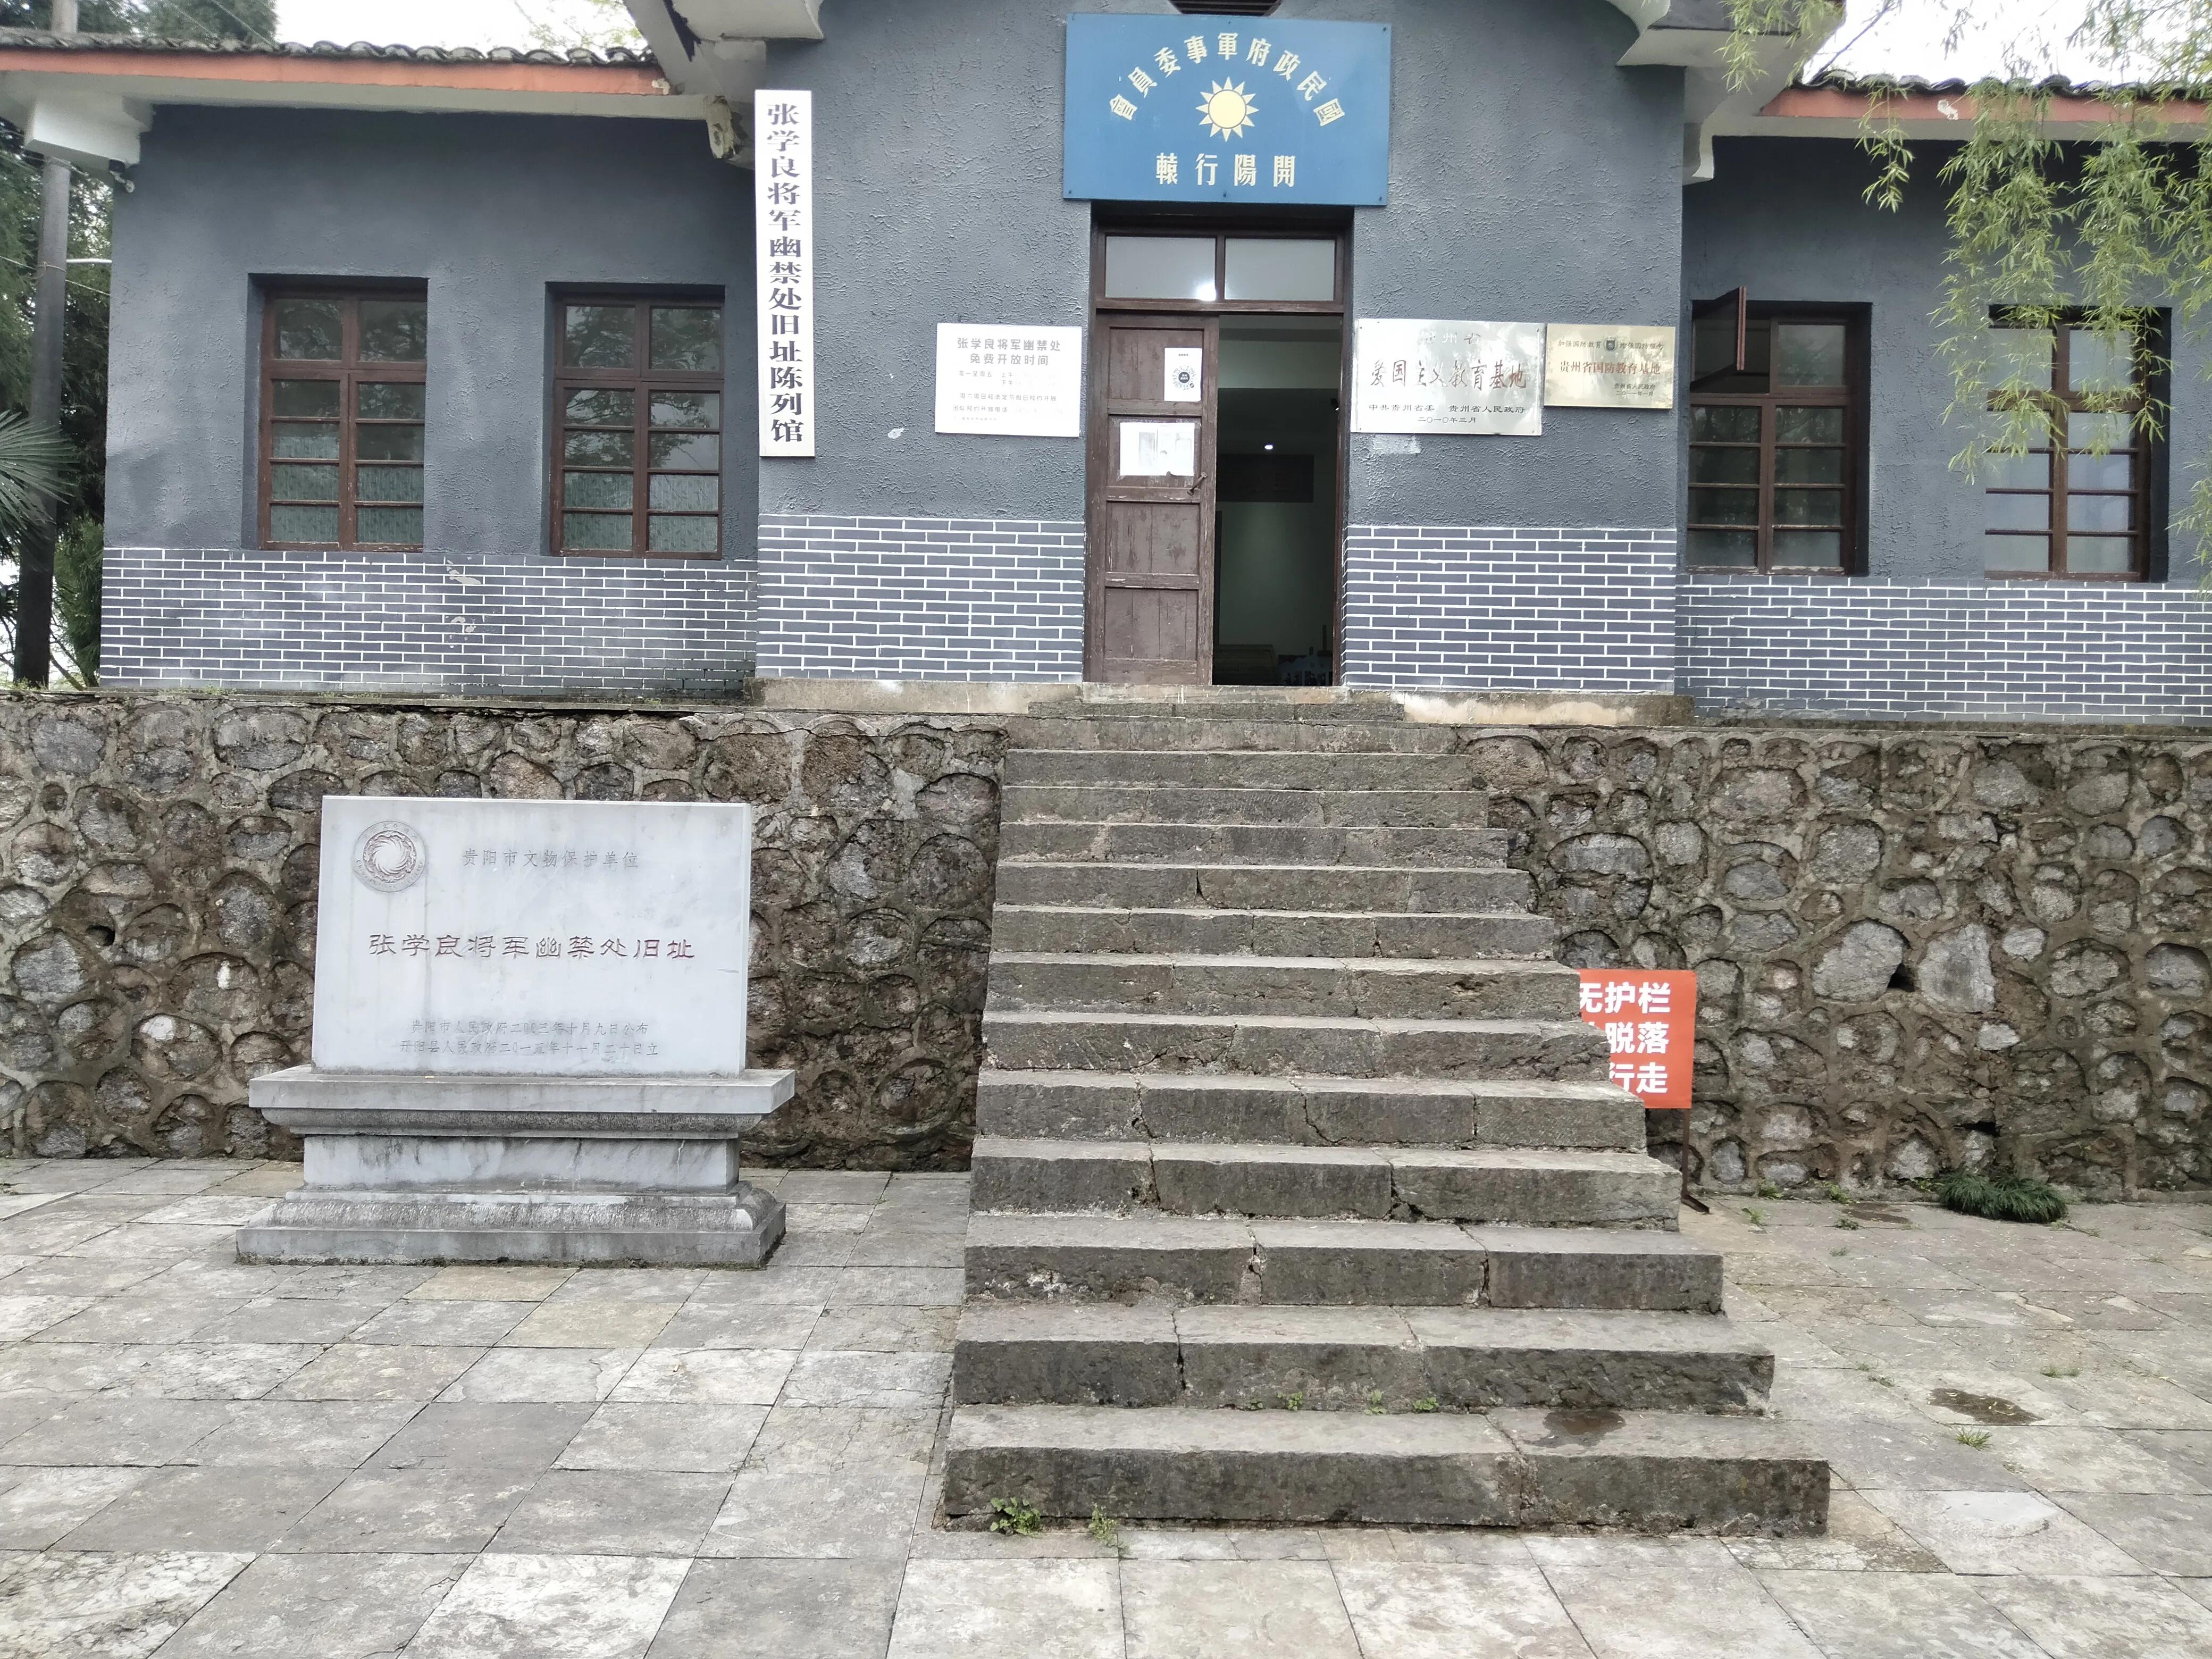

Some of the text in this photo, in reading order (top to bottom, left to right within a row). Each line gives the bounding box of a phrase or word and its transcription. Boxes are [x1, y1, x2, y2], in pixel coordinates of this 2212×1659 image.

[767, 103, 804, 442] 张学良将军幽禁处旧址陈列馆
[957, 338, 1061, 351] 张学良将军幽禁处
[970, 353, 1048, 366] 免费开放时间
[1561, 361, 1660, 375] 贵州省国防教育基地
[1370, 359, 1527, 391] 爱国主义教育基地
[462, 848, 638, 869] 贵阳市文物保护单位
[369, 934, 694, 959] 张学良将军幽禁处旧址
[1579, 982, 1671, 1014] 无护栏
[1588, 1021, 1669, 1054] 脱落
[1609, 1062, 1668, 1093] 行走
